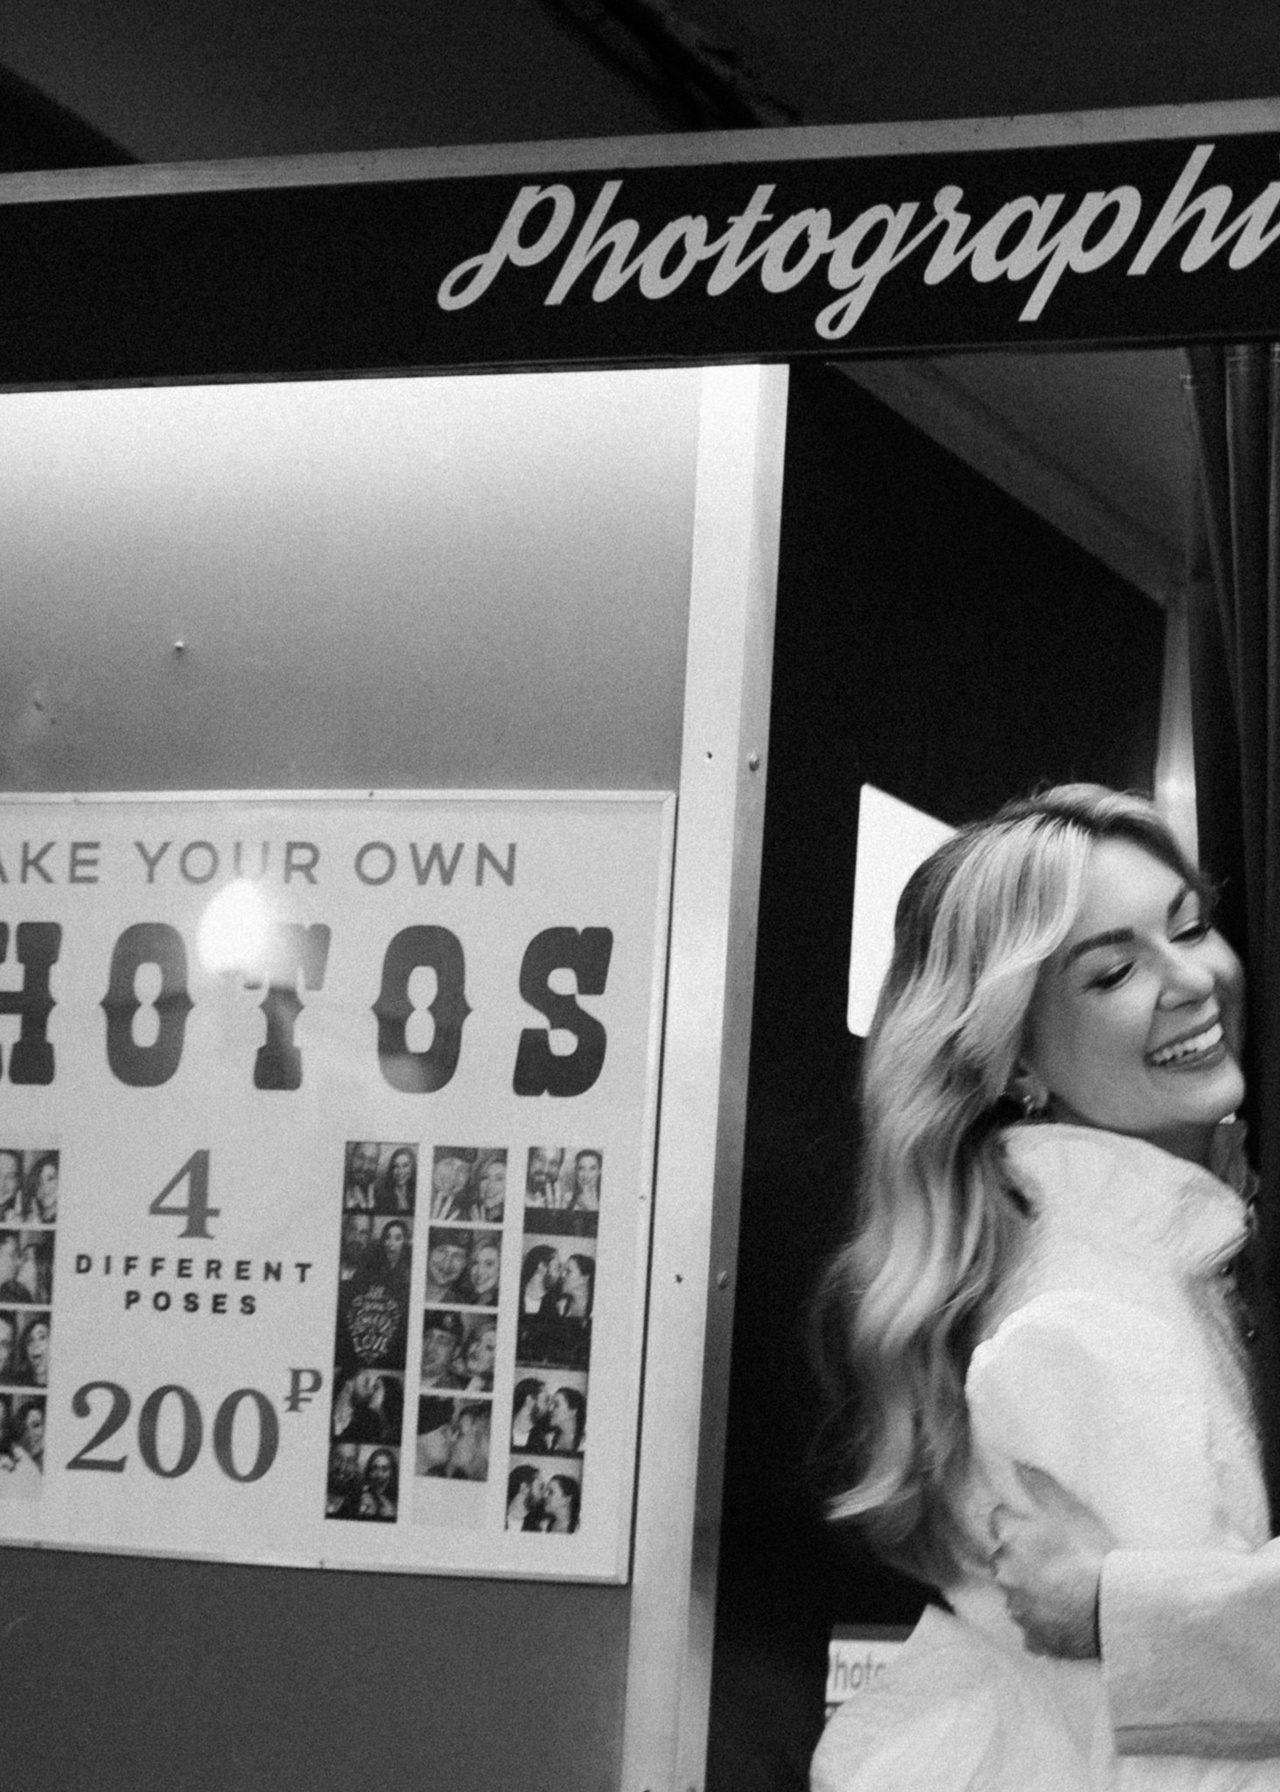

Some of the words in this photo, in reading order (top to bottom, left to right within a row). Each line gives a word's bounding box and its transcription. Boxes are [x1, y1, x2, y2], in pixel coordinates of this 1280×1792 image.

[0, 840, 100, 885] KE
[133, 840, 321, 885] YOUR
[354, 840, 518, 887] OWN
[149, 1149, 222, 1240] 4
[75, 1253, 313, 1284] DIFFERENT
[124, 1289, 257, 1316] POSES
